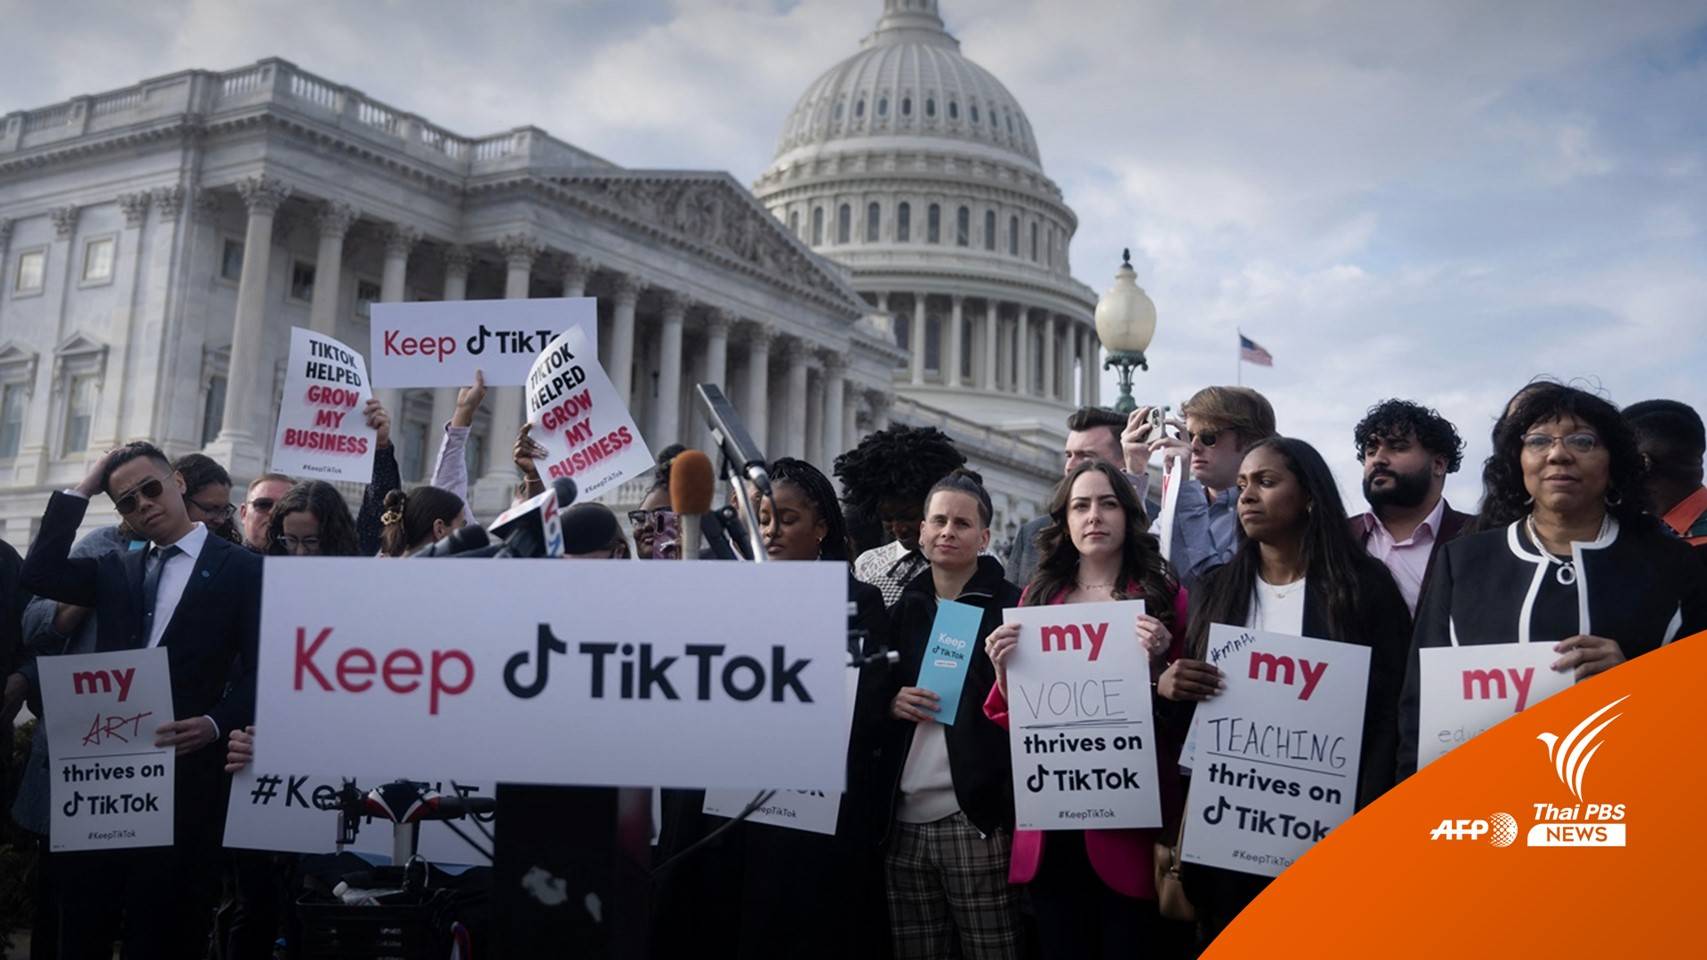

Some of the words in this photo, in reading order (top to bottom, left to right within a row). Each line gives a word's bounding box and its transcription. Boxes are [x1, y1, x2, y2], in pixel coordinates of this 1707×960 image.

[309, 340, 358, 370] TIKTOK
[384, 330, 456, 363] Keep
[495, 330, 560, 354] TikT
[305, 361, 362, 387] HELPED
[530, 343, 575, 390] TIKTOK
[307, 385, 360, 408] GROW
[531, 365, 586, 412] HELPED
[316, 409, 346, 429] MY
[542, 388, 594, 431] GROW
[284, 428, 369, 455] BUSINESS
[565, 417, 594, 448] MY
[549, 425, 633, 480] BUSINESS
[938, 632, 966, 650] Keep
[940, 648, 965, 660] TikTok
[1041, 622, 1109, 661] my
[73, 668, 136, 702] my
[293, 626, 476, 716] Keep
[578, 642, 815, 703] TikTok
[1248, 651, 1329, 701] my
[1020, 679, 1126, 719] VOICE
[1462, 667, 1535, 713] my
[82, 711, 153, 746] ART
[1024, 733, 1106, 754] thrives
[1113, 735, 1143, 751] on
[1208, 717, 1347, 769] TEACHING
[62, 763, 135, 783] thrives
[141, 764, 164, 778] on
[1053, 767, 1140, 791] TikTok
[1208, 763, 1300, 798] thrives
[1309, 786, 1341, 804] on
[87, 792, 159, 816] TikTok
[1058, 808, 1115, 820] #KeepTikTok
[88, 831, 136, 841] #KeepTikTok
[1235, 806, 1331, 843] TikTok
